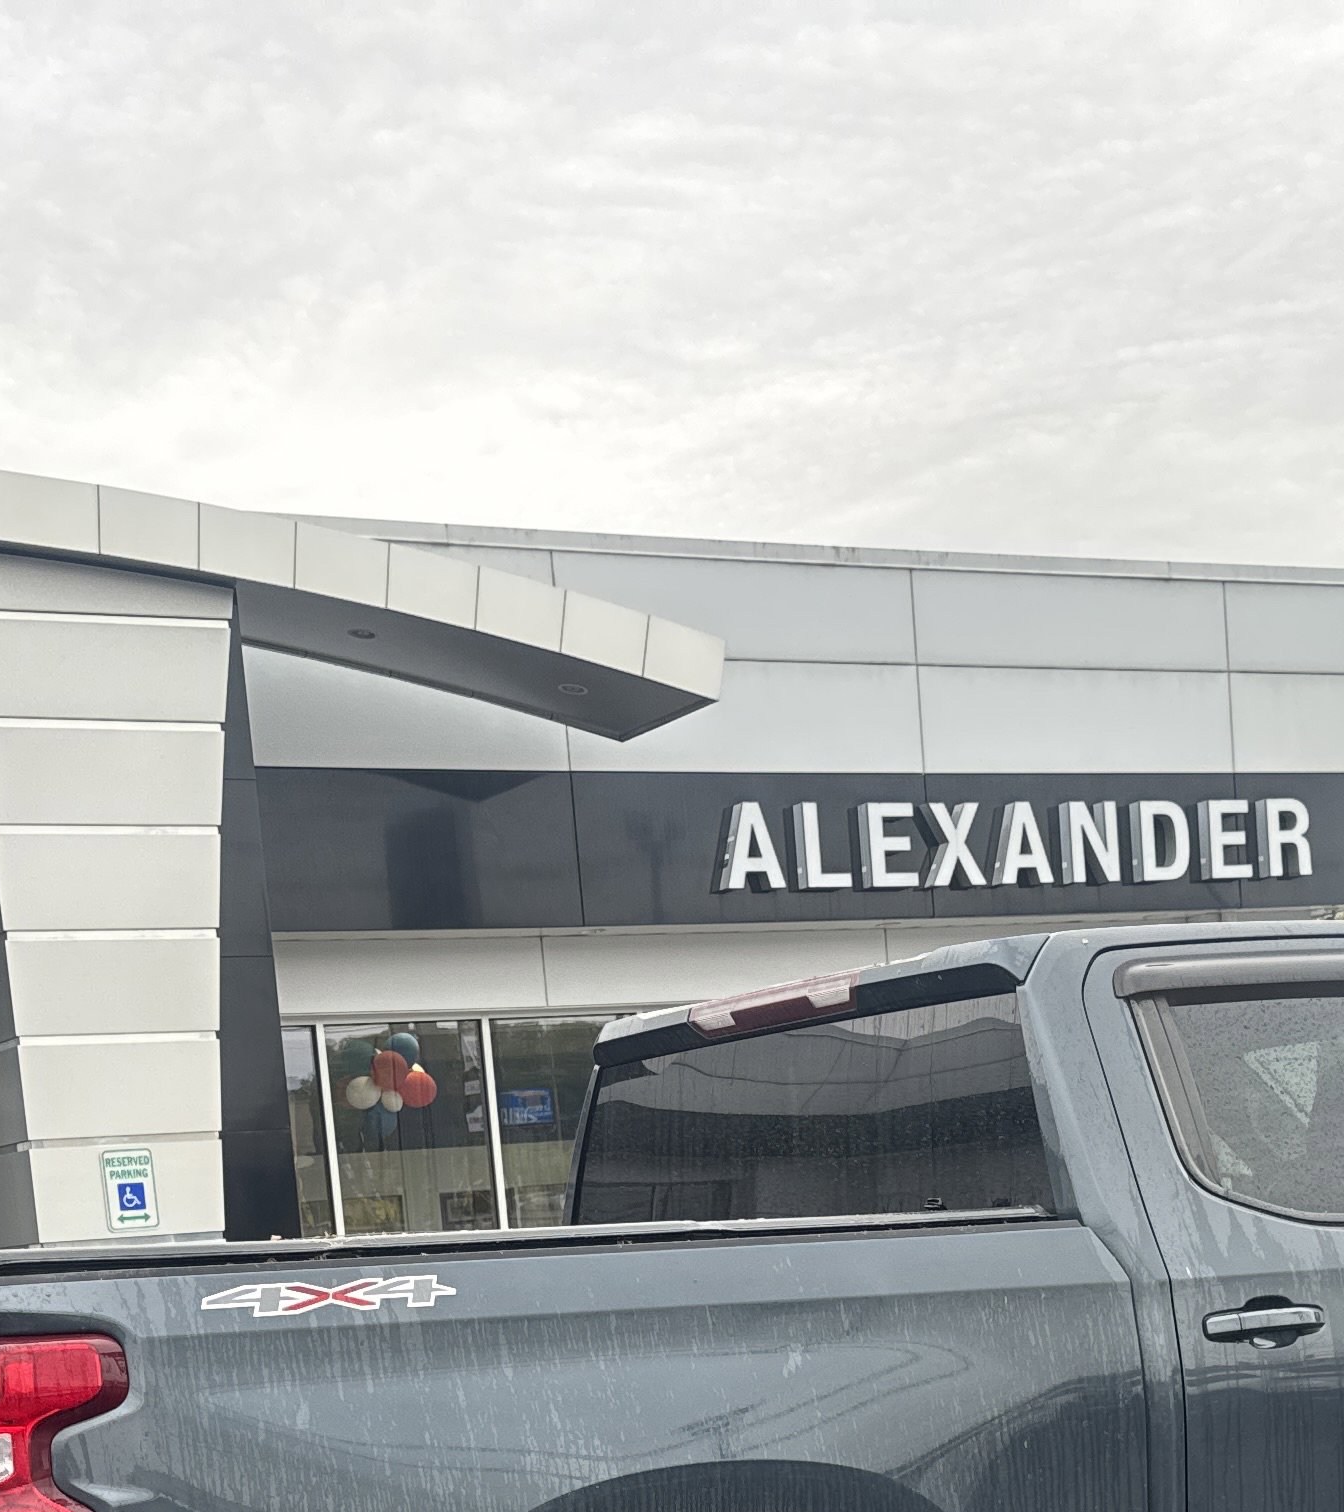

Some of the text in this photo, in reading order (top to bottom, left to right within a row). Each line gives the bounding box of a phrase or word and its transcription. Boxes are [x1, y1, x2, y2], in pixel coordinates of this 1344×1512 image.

[720, 797, 1313, 890] ALEXANDER
[104, 1155, 150, 1168] RESERVED
[109, 1168, 149, 1180] PARKING
